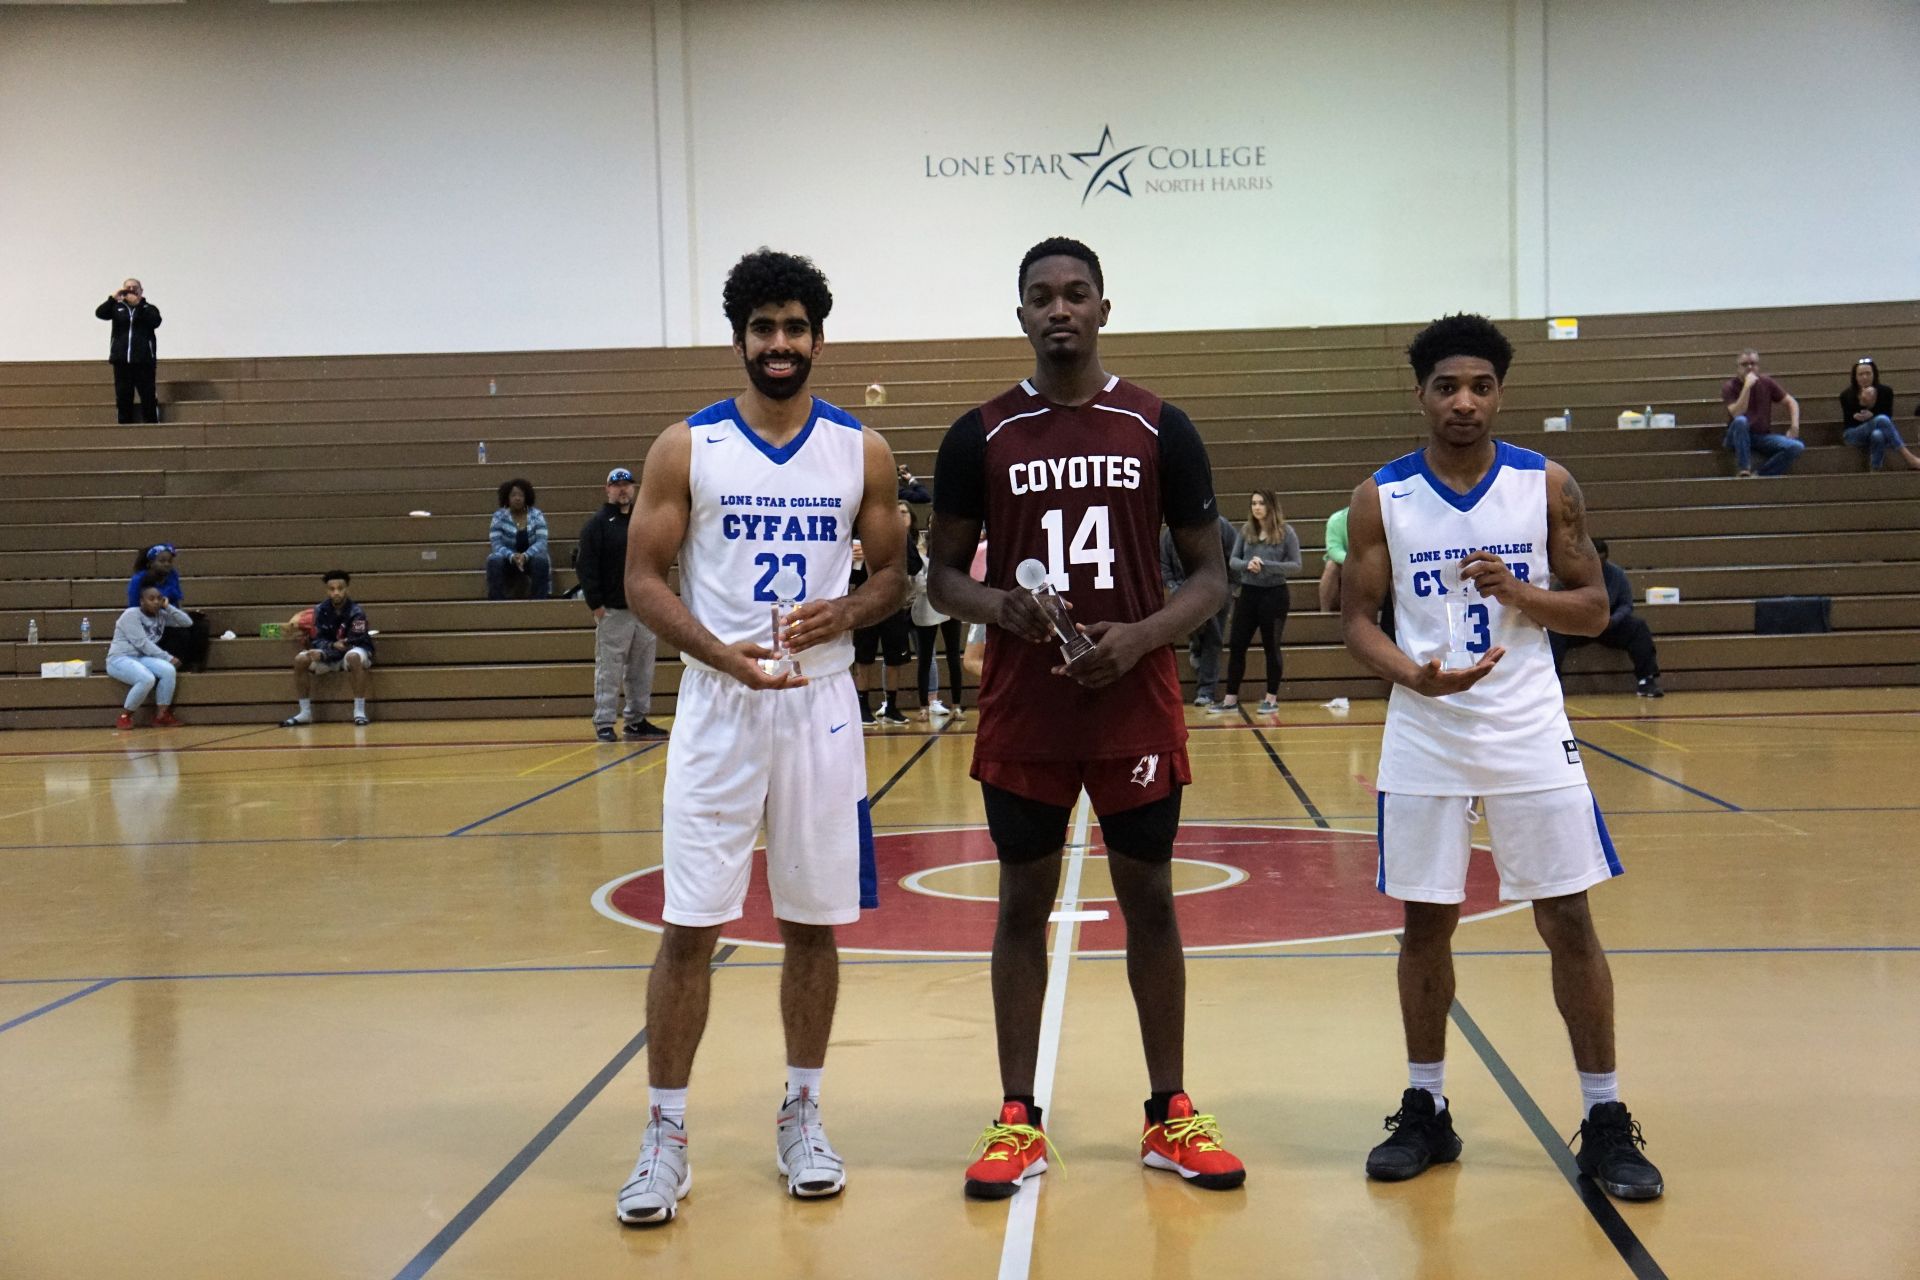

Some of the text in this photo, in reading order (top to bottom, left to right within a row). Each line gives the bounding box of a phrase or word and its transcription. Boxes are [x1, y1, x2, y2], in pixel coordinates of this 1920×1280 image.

[925, 146, 1266, 180] LONE STAR COLLEGE
[1145, 176, 1273, 193] NORTH HARRIS
[1008, 455, 1141, 496] COYOTES
[720, 495, 842, 509] LONE STAR COLLEGE
[723, 514, 838, 542] CYFAIR
[1041, 505, 1115, 596] 14
[1410, 550, 1441, 564] LONE
[754, 552, 806, 602] 23
[1466, 603, 1491, 654] 3
